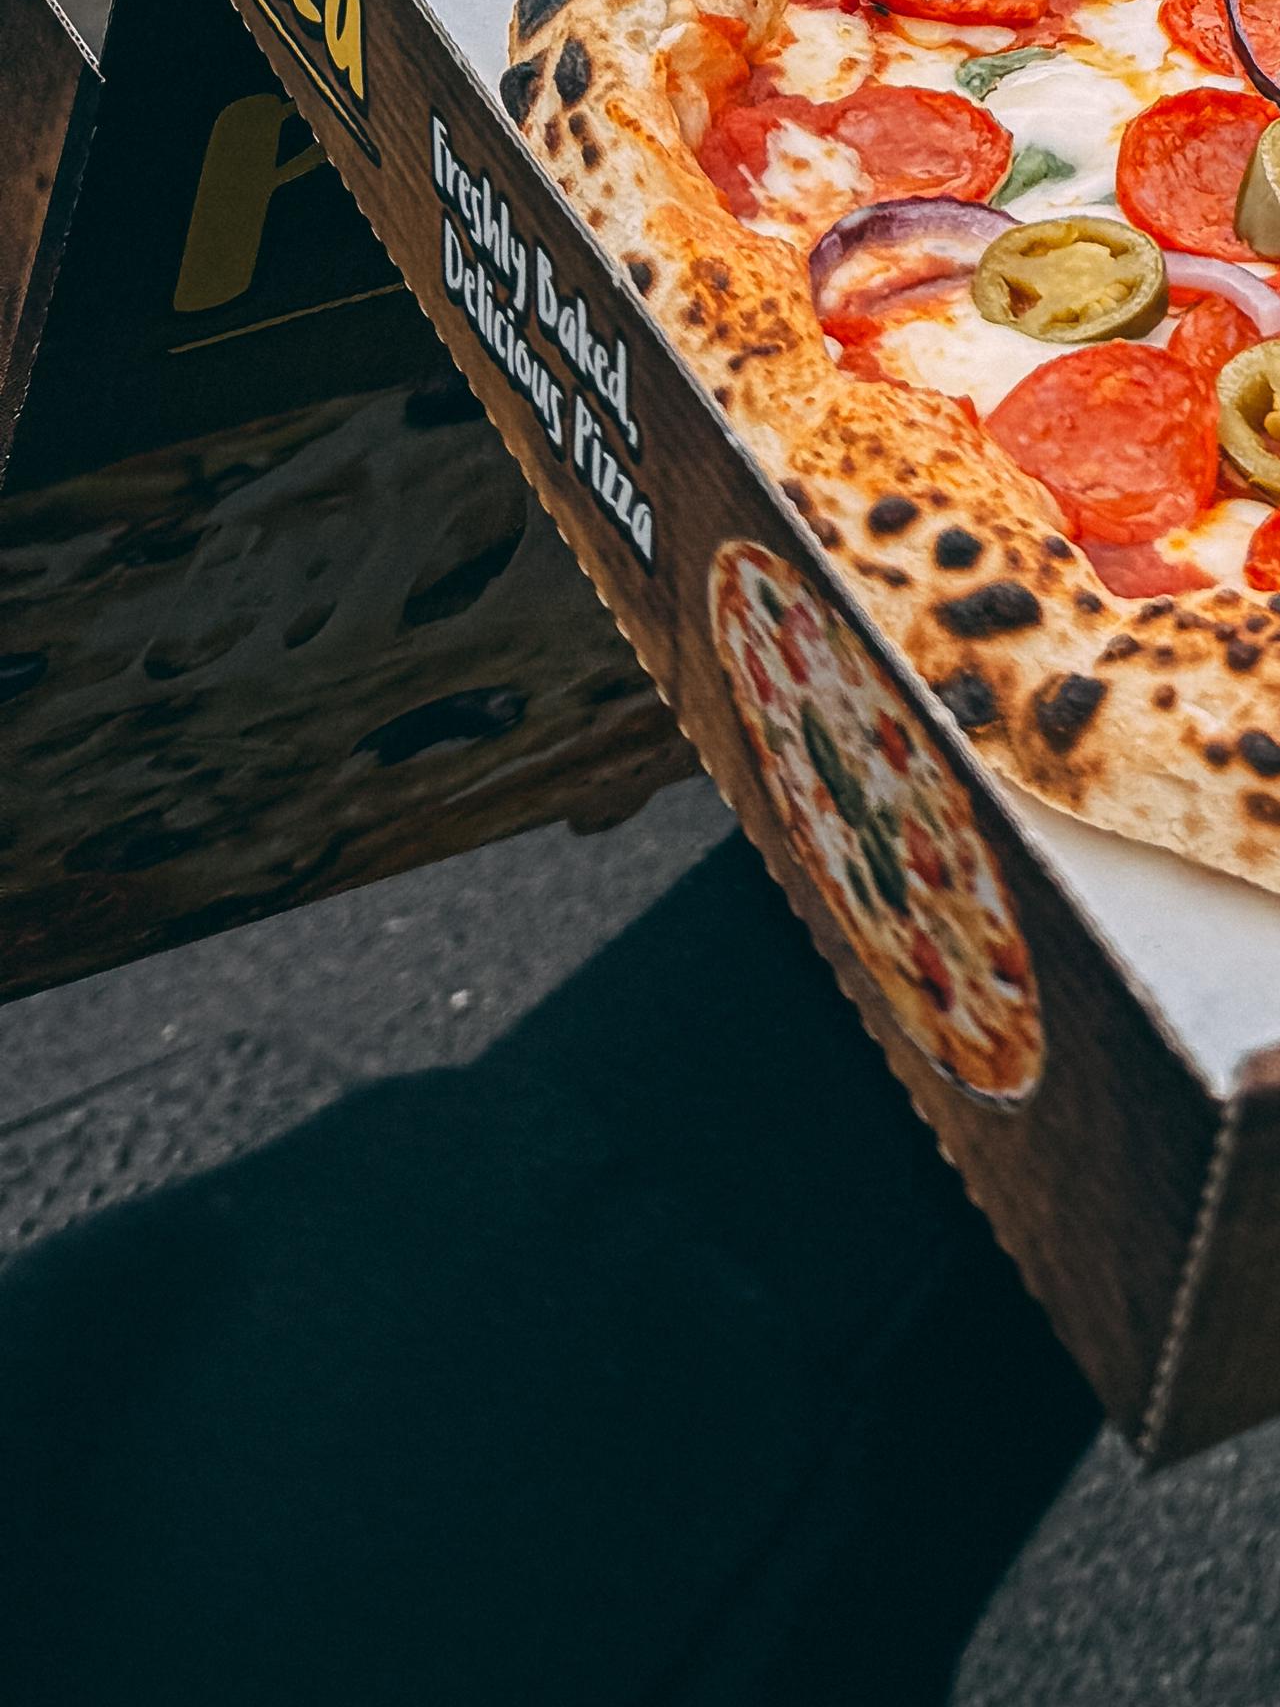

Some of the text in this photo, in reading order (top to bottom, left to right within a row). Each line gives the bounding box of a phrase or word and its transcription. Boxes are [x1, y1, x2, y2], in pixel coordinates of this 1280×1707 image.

[432, 115, 638, 447] Freshly Baked,
[443, 218, 653, 562] Delicious Pizza
